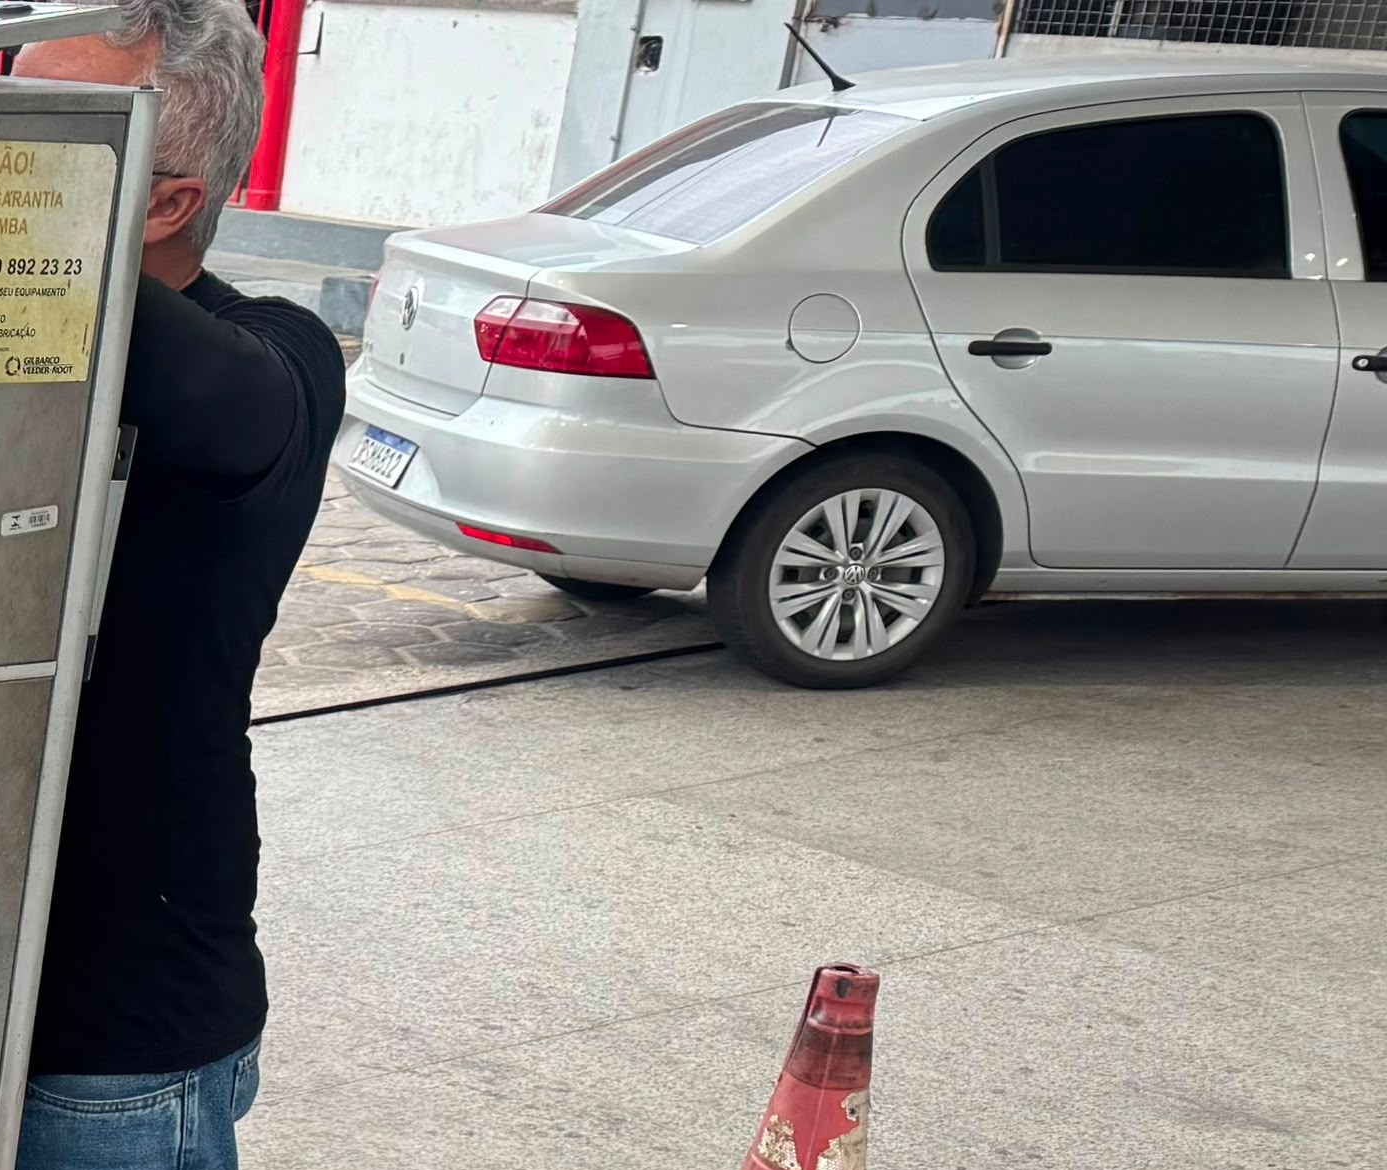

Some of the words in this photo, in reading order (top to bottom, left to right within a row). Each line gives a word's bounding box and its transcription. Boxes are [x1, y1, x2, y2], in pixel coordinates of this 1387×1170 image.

[8, 258, 36, 275] 892
[40, 258, 59, 275] 23
[63, 258, 83, 275] 23
[14, 287, 67, 297] EQUIPAMENTO
[24, 356, 60, 365] GILBARCO
